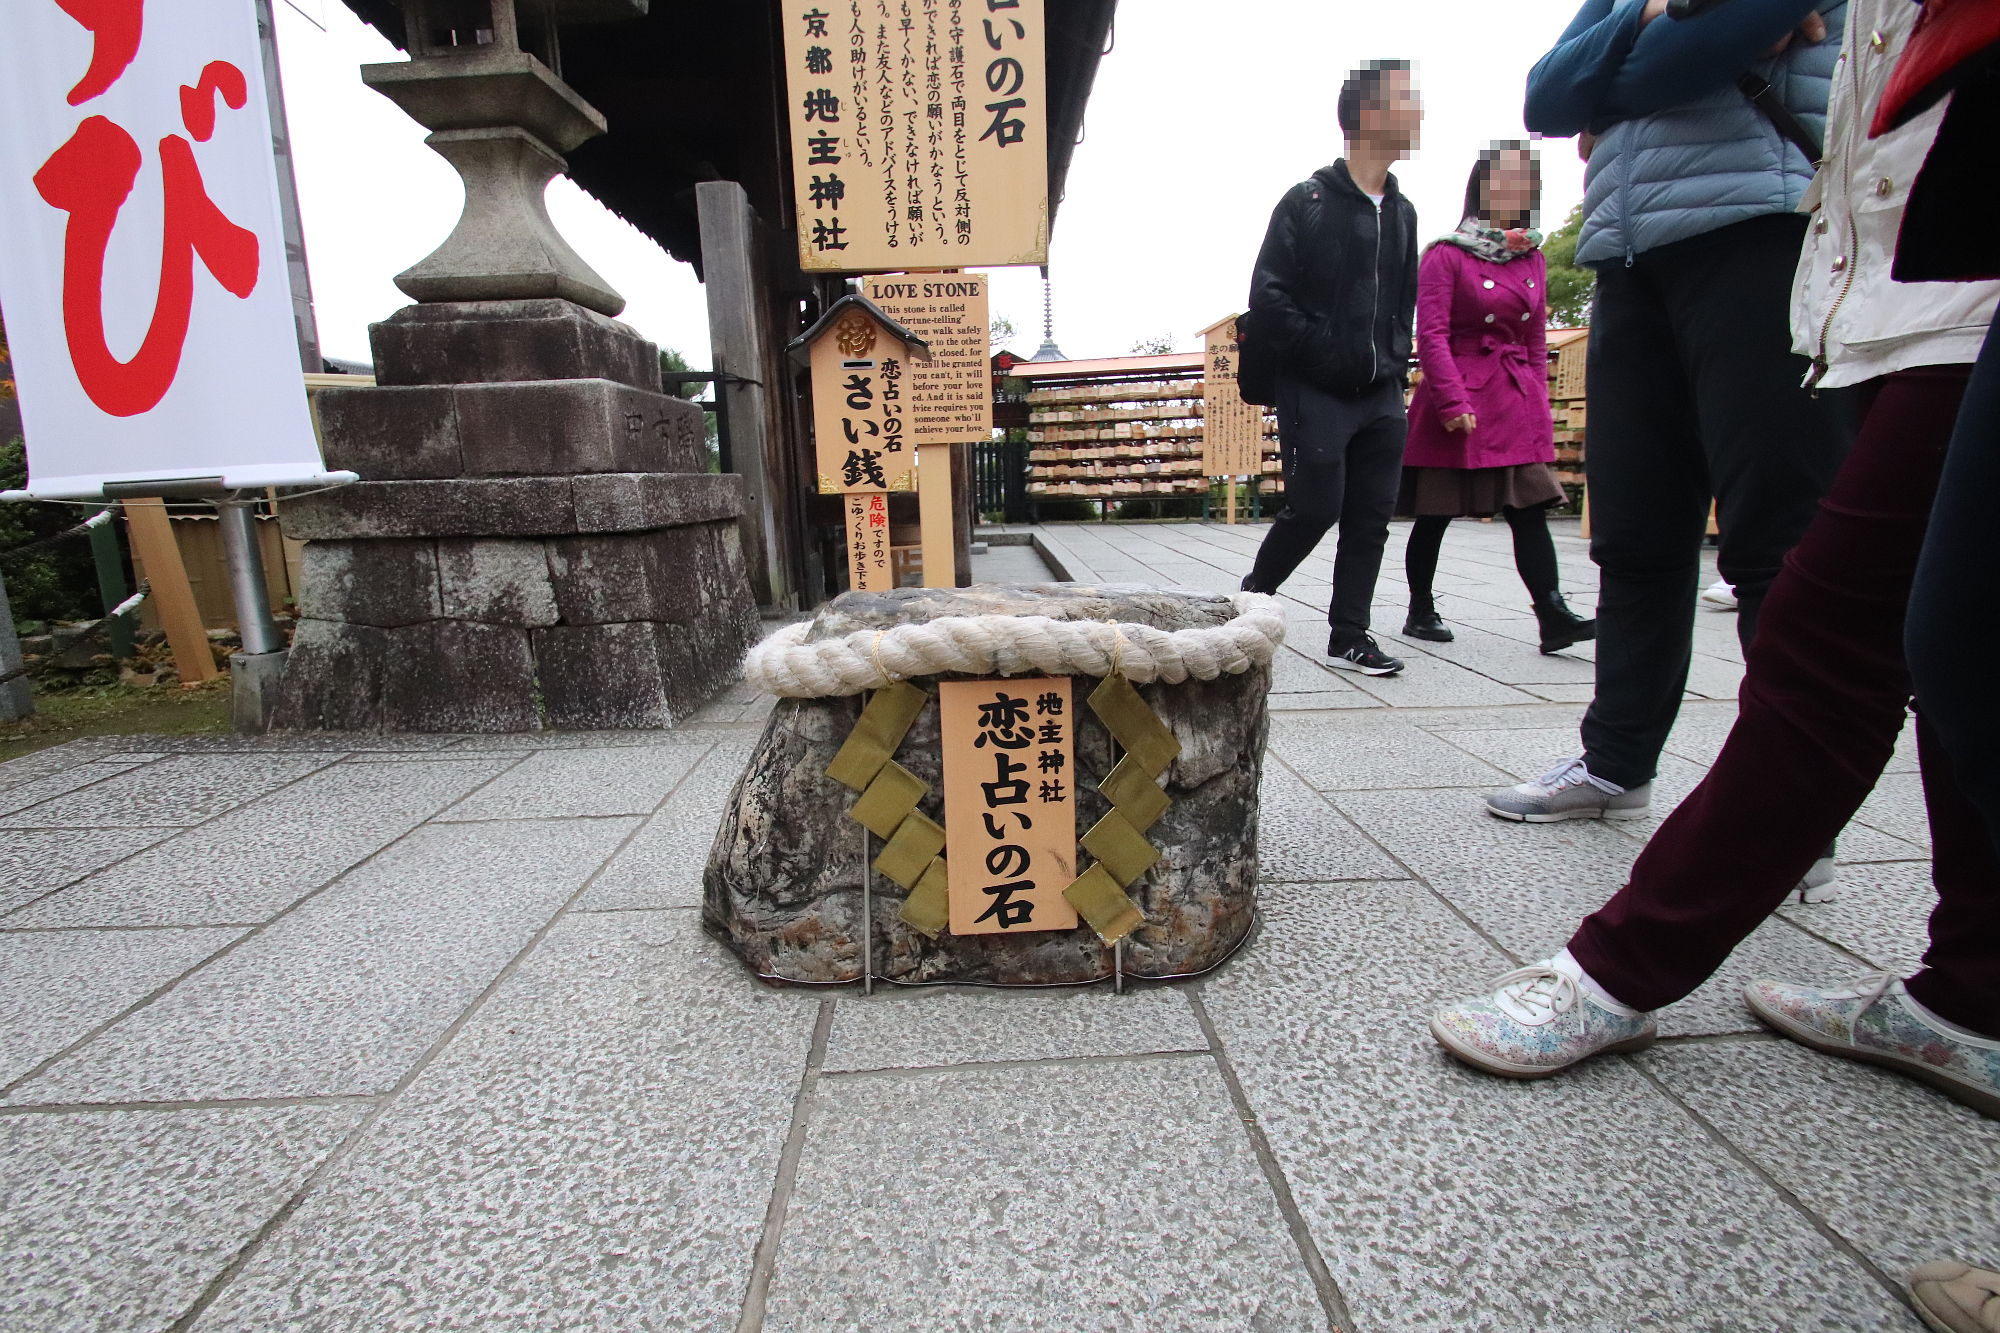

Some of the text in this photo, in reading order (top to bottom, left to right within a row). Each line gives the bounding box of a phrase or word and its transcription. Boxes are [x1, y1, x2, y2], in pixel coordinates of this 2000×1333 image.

[873, 282, 980, 299] LOVE STONE
[881, 305, 900, 313] This
[929, 304, 937, 313] is
[940, 303, 965, 312] called
[933, 327, 953, 335] walk
[957, 326, 981, 335] safely
[936, 338, 944, 346] to
[961, 337, 982, 345] other
[941, 360, 951, 368] be
[952, 359, 983, 368] granted
[913, 372, 928, 380] you
[967, 370, 983, 378] will
[912, 382, 940, 390] before
[967, 381, 983, 389] love
[946, 392, 953, 400] it
[956, 392, 964, 400] is
[967, 391, 983, 399] said
[880, 358, 903, 453] 恋占いの石
[934, 403, 968, 411] requires
[970, 403, 984, 411] you
[914, 413, 981, 423] someone who'll
[841, 374, 887, 489] さい銭
[914, 425, 943, 433] achieve
[869, 495, 886, 568] 危険ですので
[1036, 691, 1067, 804] 地主神社
[973, 692, 1036, 930] 恋占いの石
